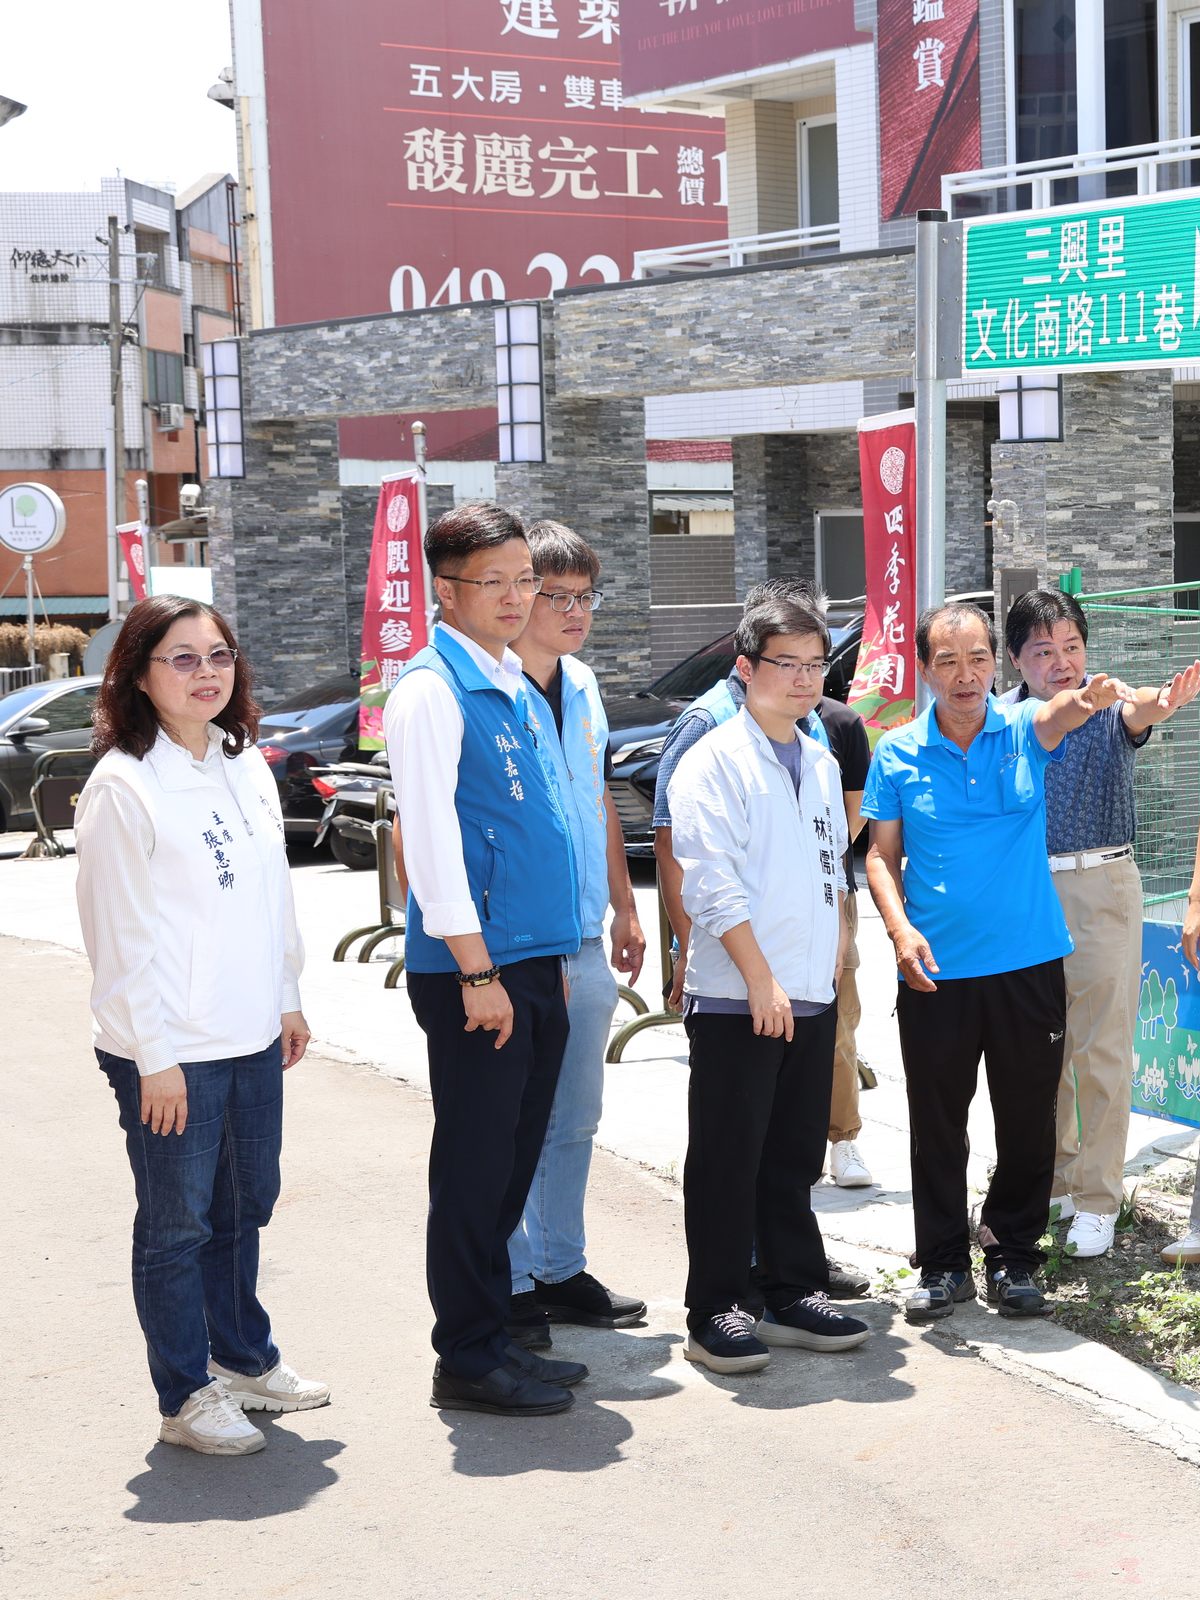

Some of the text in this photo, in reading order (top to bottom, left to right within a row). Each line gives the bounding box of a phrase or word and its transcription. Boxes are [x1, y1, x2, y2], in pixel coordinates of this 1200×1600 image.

[638, 34, 658, 50] LIVE
[662, 29, 679, 45] THE
[681, 25, 700, 41] LIFE
[704, 19, 722, 35] YOU
[758, 5, 784, 21] LOVE
[788, 0, 807, 15] THE
[402, 127, 663, 200] 馥麗完工
[677, 145, 705, 206] 總價
[1023, 216, 1127, 284] 三興里
[971, 284, 1184, 361] 文化南路111巷
[867, 505, 906, 695] 四季花園
[202, 829, 235, 890] 張惠卿
